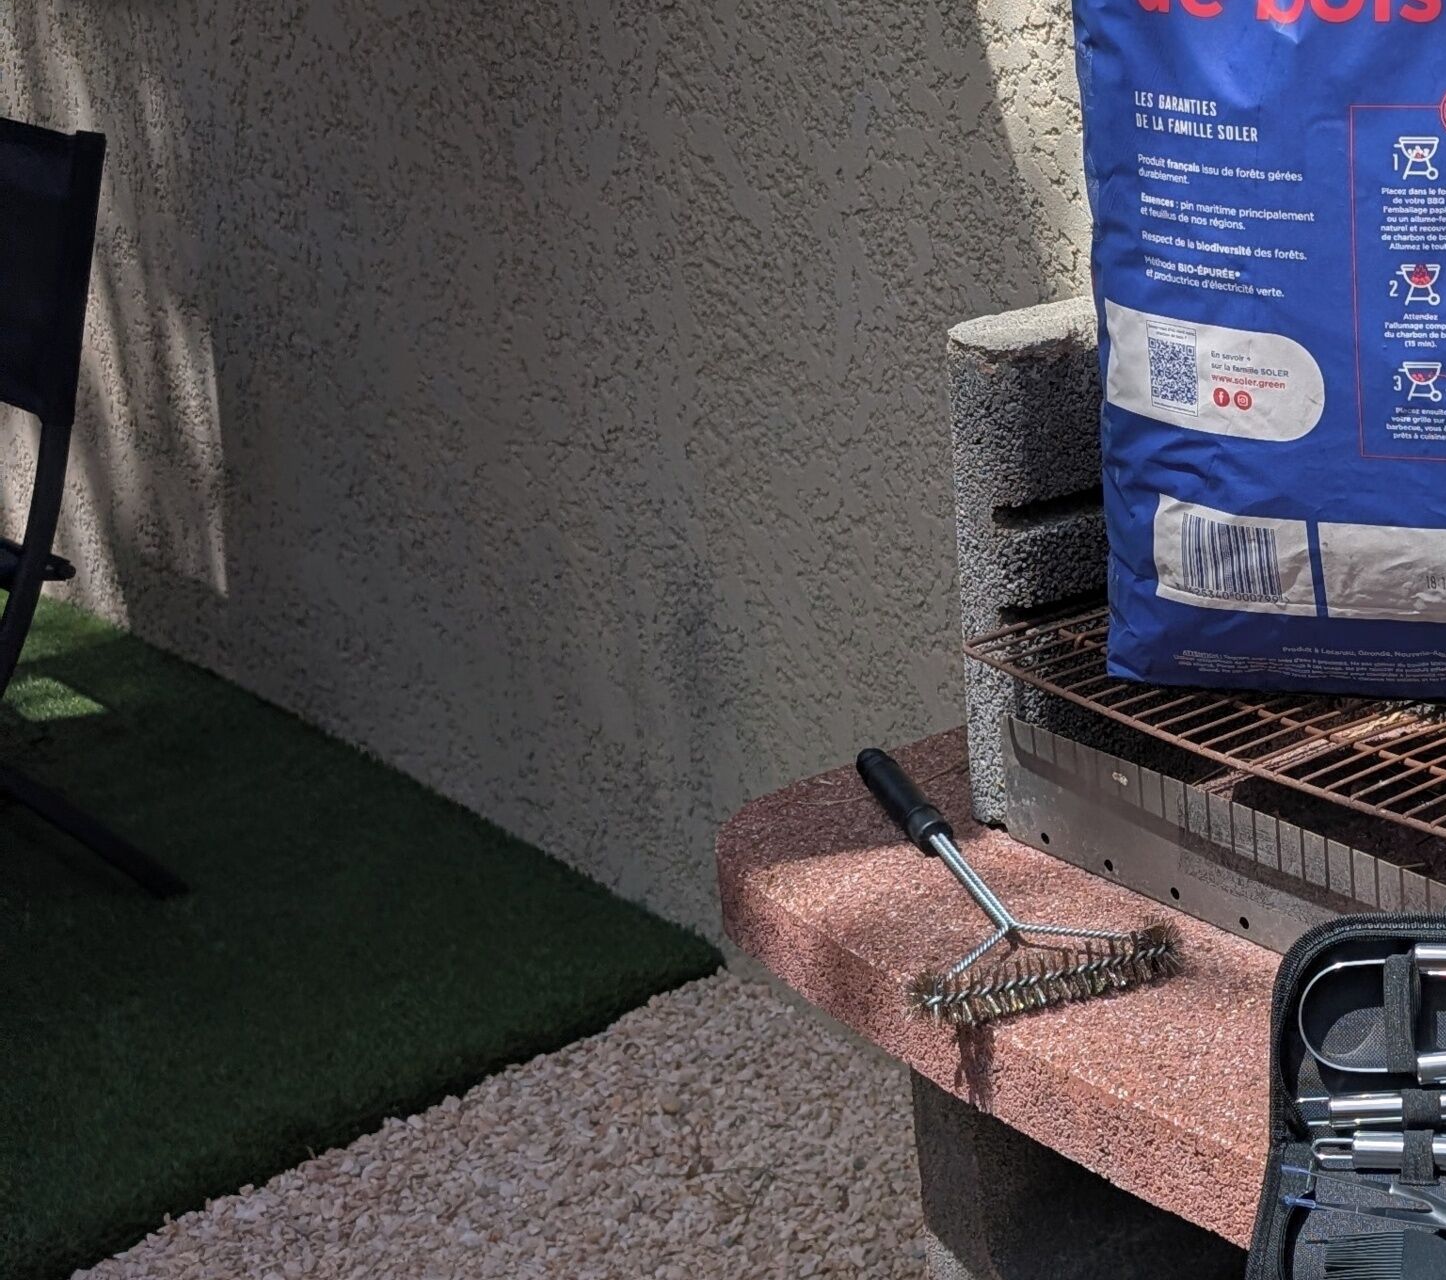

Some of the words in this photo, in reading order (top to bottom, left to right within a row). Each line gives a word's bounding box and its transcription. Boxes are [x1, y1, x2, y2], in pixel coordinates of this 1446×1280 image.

[1135, 91, 1154, 108] LES
[1158, 94, 1217, 117] GARANTIES
[1136, 113, 1148, 128] DE
[1153, 116, 1164, 132] LA
[1168, 118, 1213, 139] FAMILLE
[1218, 124, 1258, 142] SOLER
[1138, 154, 1165, 168] Produit
[1167, 159, 1200, 173] français
[1202, 164, 1219, 176] issu
[1222, 166, 1233, 177] de
[1236, 168, 1265, 180] forêts
[1268, 170, 1303, 182] gérées
[1392, 153, 1399, 171] 1
[1139, 167, 1190, 184] durablement.
[1381, 187, 1407, 195] Placez
[1408, 187, 1427, 195] dans
[1141, 192, 1174, 208] Essences
[1181, 201, 1194, 211] pin
[1196, 204, 1236, 216] maritime
[1239, 209, 1315, 221] principalement
[1427, 197, 1445, 205] BBQ
[1140, 206, 1148, 215] et
[1149, 207, 1177, 221] feuillus
[1178, 213, 1189, 222] de
[1191, 216, 1207, 225] nos
[1209, 217, 1246, 230] régions.
[1380, 224, 1408, 232] naturel
[1142, 230, 1173, 246] Respect
[1175, 237, 1185, 247] de
[1187, 239, 1194, 249] la
[1196, 241, 1251, 256] biodiversité
[1254, 247, 1272, 258] des
[1274, 249, 1307, 260] forêts.
[1146, 268, 1154, 278] et
[1154, 270, 1200, 287] productrice
[1202, 279, 1254, 294] d'électricité
[1256, 288, 1285, 297] verte.
[1389, 280, 1399, 297] 2
[1403, 313, 1438, 321] Attendez
[1211, 350, 1220, 358] En
[1222, 353, 1244, 362] savoir
[1224, 364, 1231, 372] la
[1232, 365, 1259, 376] famille
[1261, 368, 1289, 378] SOLER
[1211, 374, 1286, 390] www.soler.green
[1393, 375, 1401, 391] 3
[1412, 416, 1431, 424] grille
[1235, 591, 1279, 604] 000799
